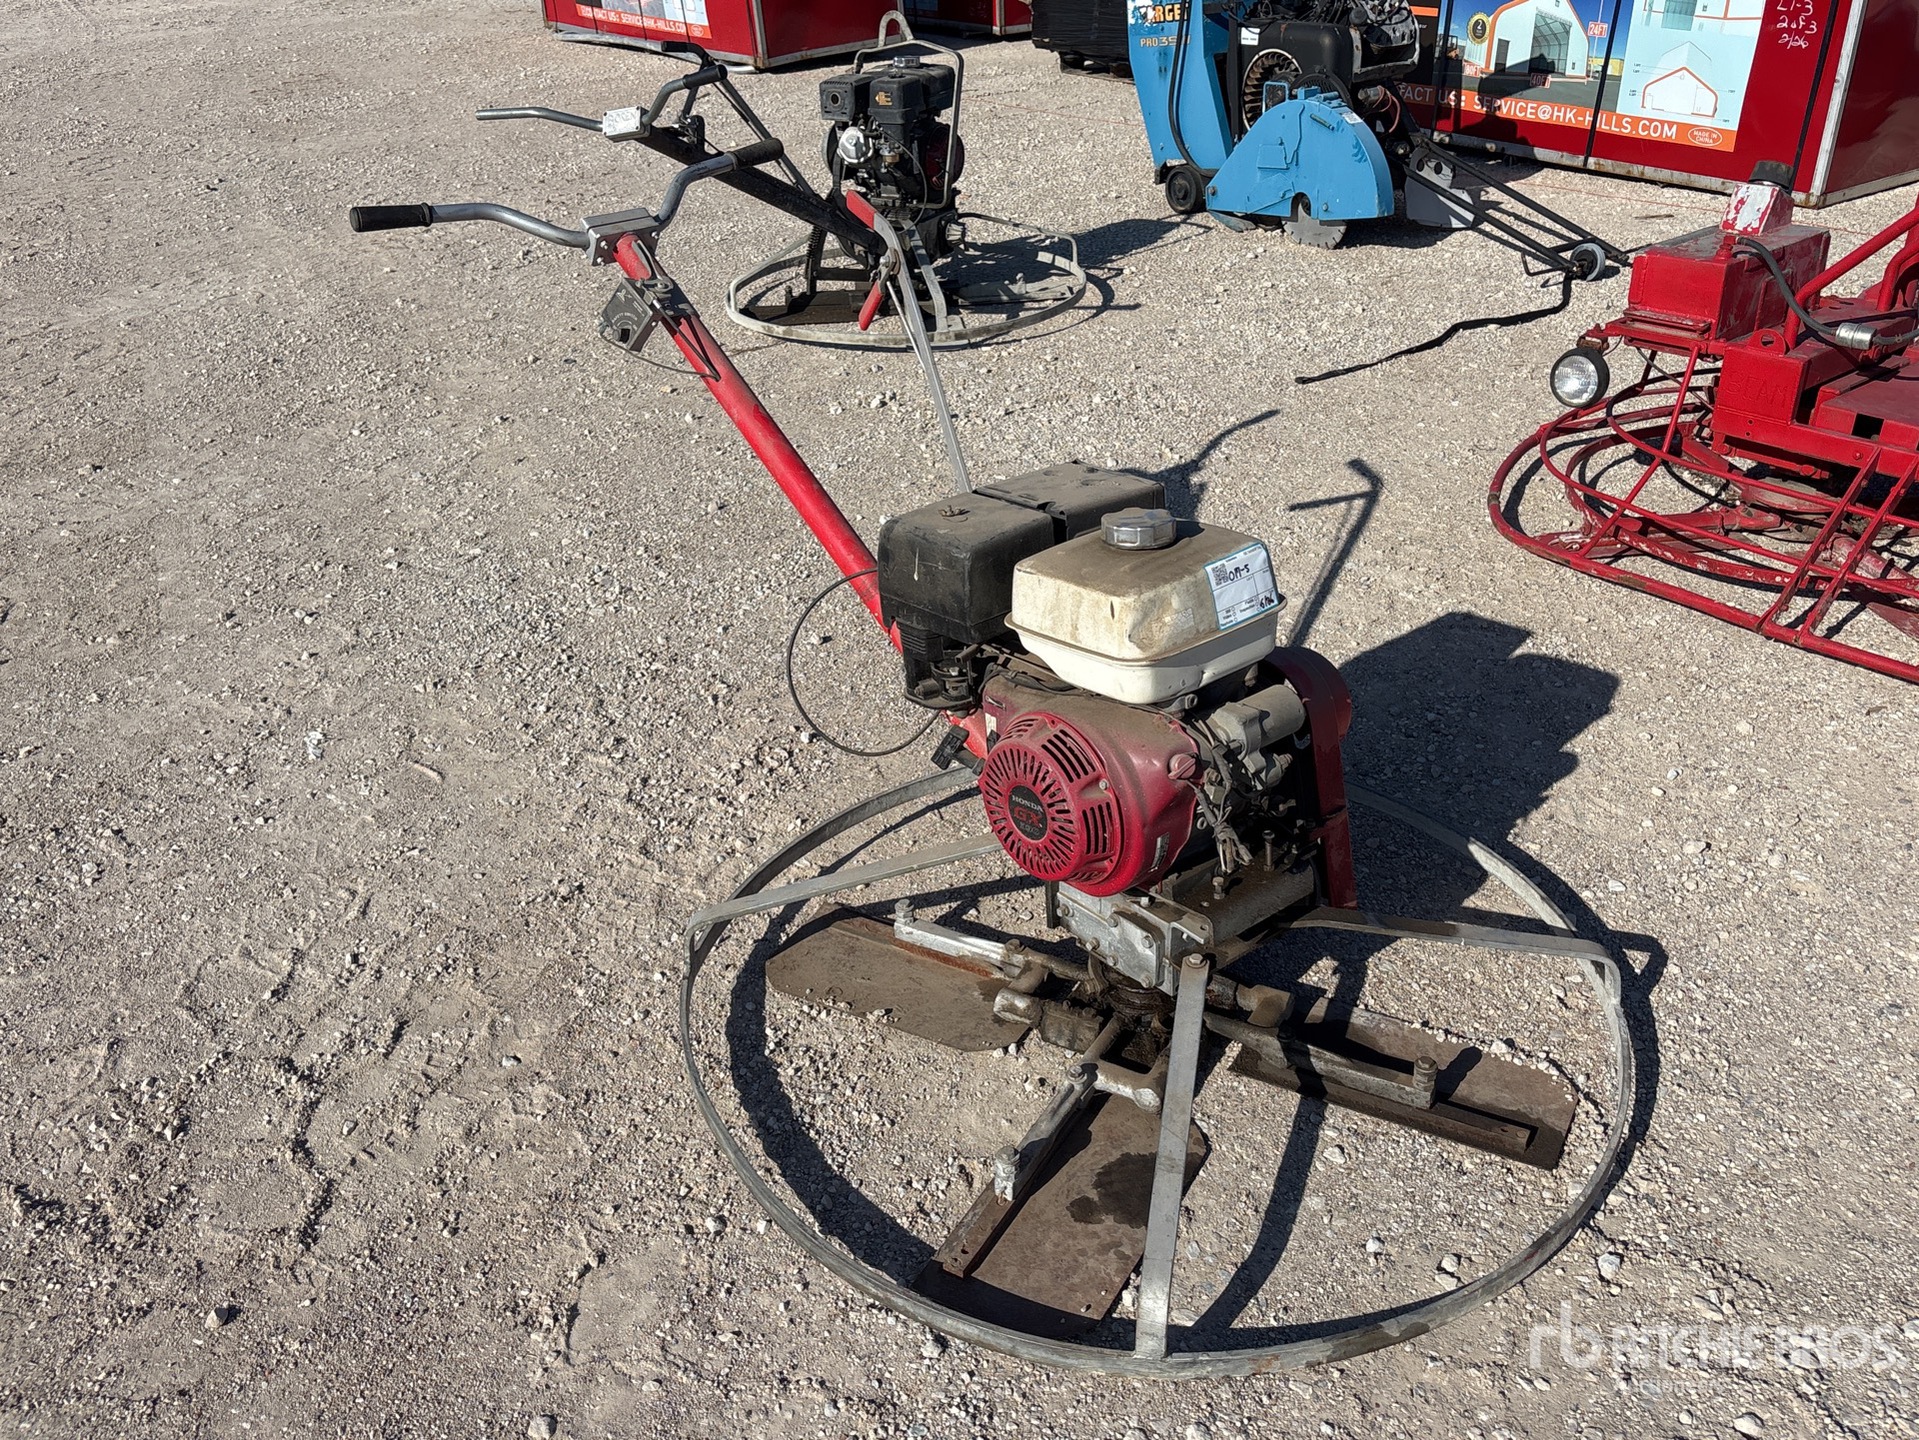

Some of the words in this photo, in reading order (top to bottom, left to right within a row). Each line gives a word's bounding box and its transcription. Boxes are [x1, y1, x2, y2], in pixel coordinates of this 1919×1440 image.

[1589, 23, 1608, 37] 24FT
[1776, 15, 1788, 28] 2
[1804, 20, 1817, 34] 3
[1012, 795, 1043, 812] HONDA
